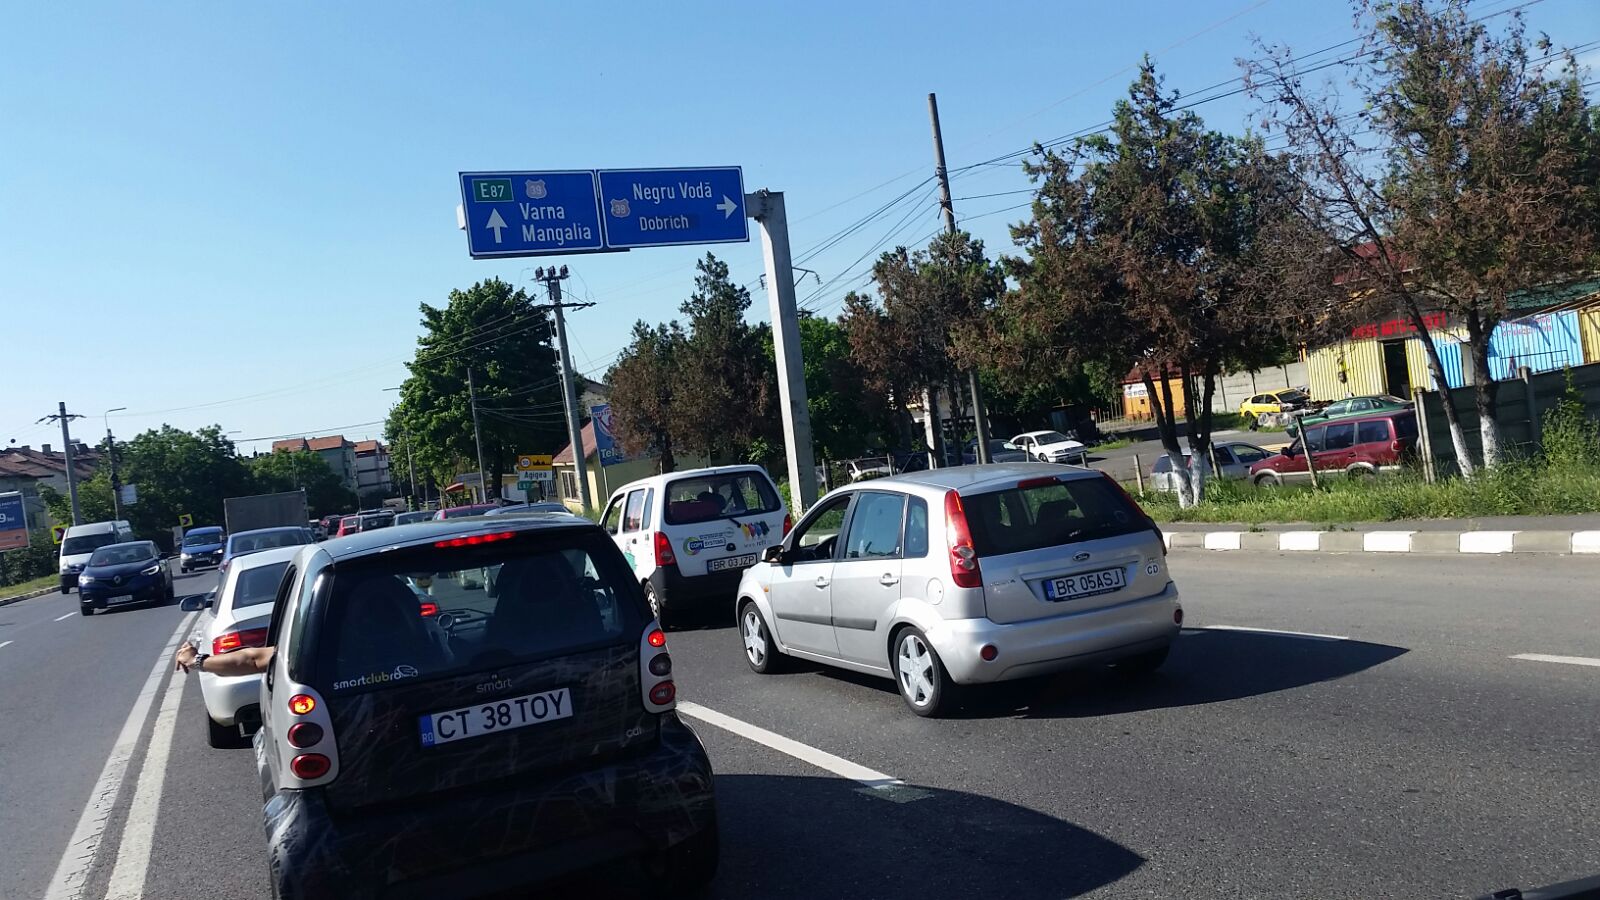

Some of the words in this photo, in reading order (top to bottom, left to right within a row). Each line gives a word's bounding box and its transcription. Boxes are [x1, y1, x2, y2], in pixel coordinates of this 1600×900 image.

[480, 182, 504, 198] E87
[632, 182, 675, 204] Negru
[519, 202, 565, 220] Varna
[638, 214, 689, 231] Dobrich
[521, 222, 591, 246] Mangalia
[713, 560, 726, 570] BR
[1147, 564, 1158, 575] CD
[1055, 578, 1077, 596] BR
[437, 710, 470, 739] CT
[422, 731, 434, 744] RO
